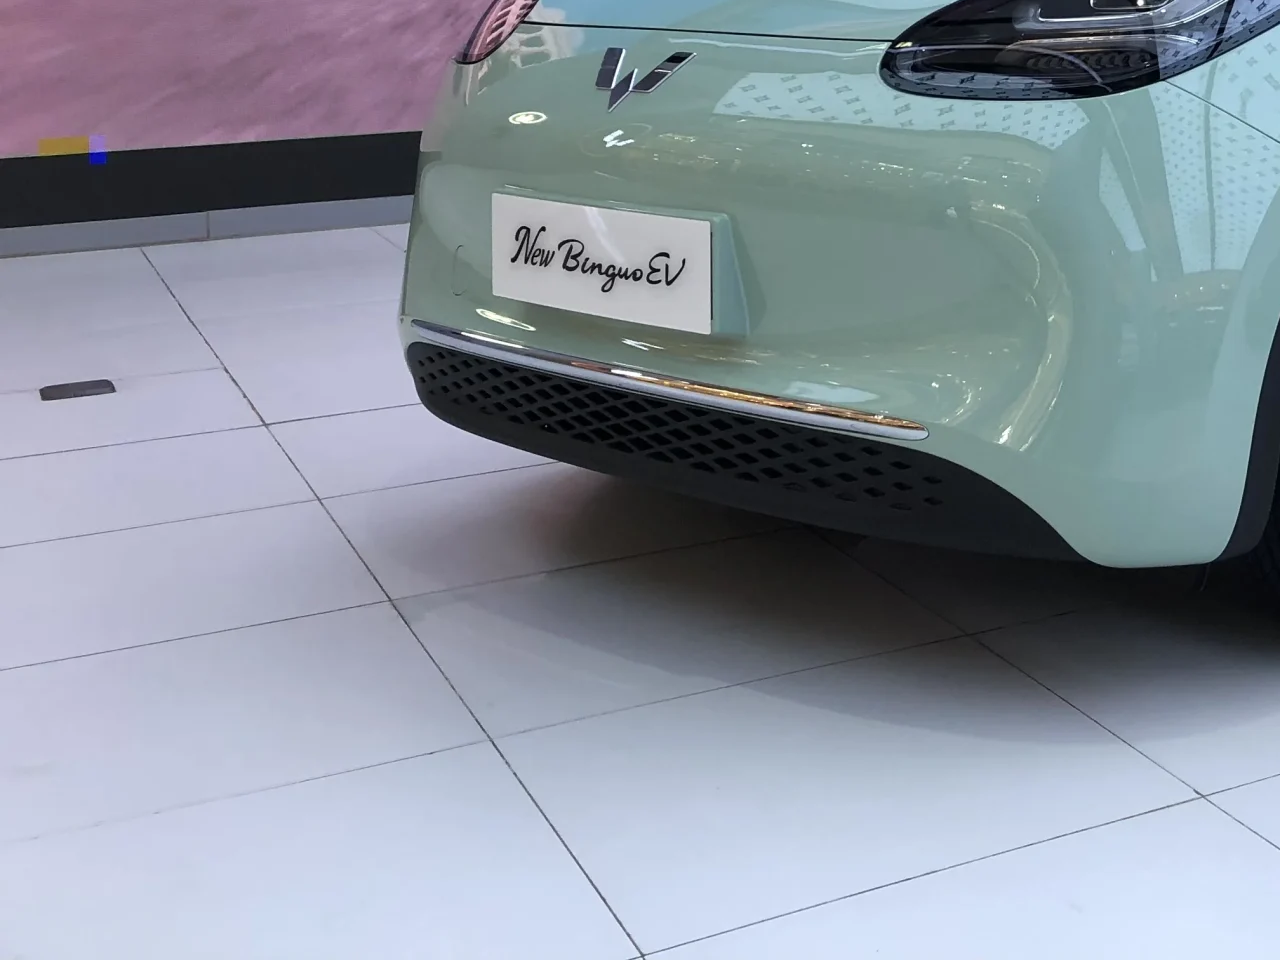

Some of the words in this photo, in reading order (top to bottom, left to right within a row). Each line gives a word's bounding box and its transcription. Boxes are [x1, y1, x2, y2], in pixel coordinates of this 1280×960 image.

[510, 225, 556, 268] New
[557, 238, 644, 293] Binguo
[645, 251, 686, 286] EV
